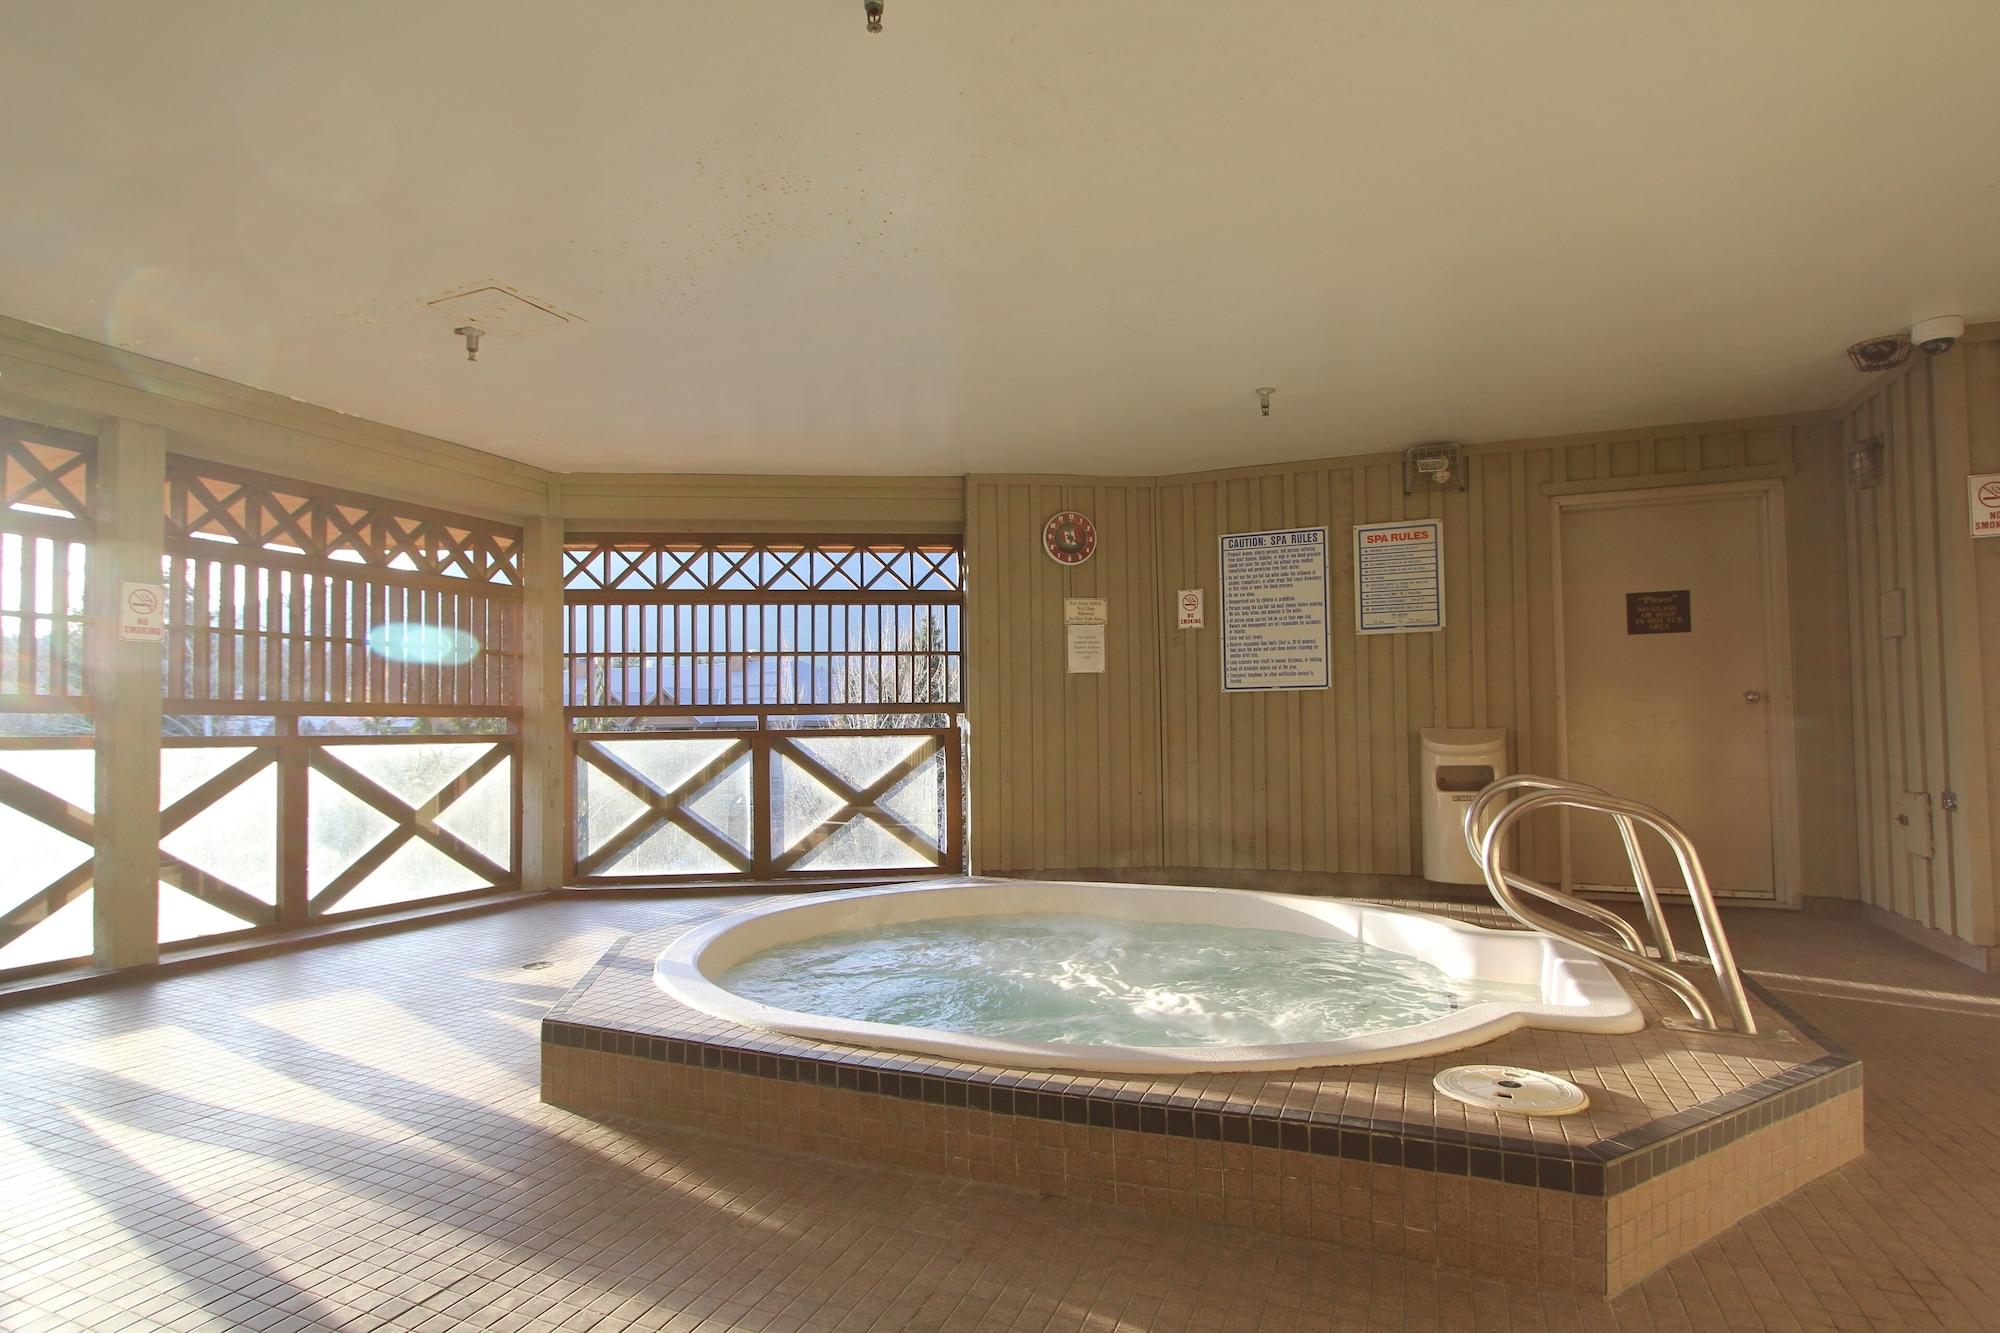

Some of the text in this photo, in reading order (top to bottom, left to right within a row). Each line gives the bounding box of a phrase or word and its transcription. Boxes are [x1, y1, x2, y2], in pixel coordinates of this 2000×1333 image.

[1229, 533, 1318, 548] CAUTION: SPA RULES
[1367, 531, 1429, 543] SPA RULES
